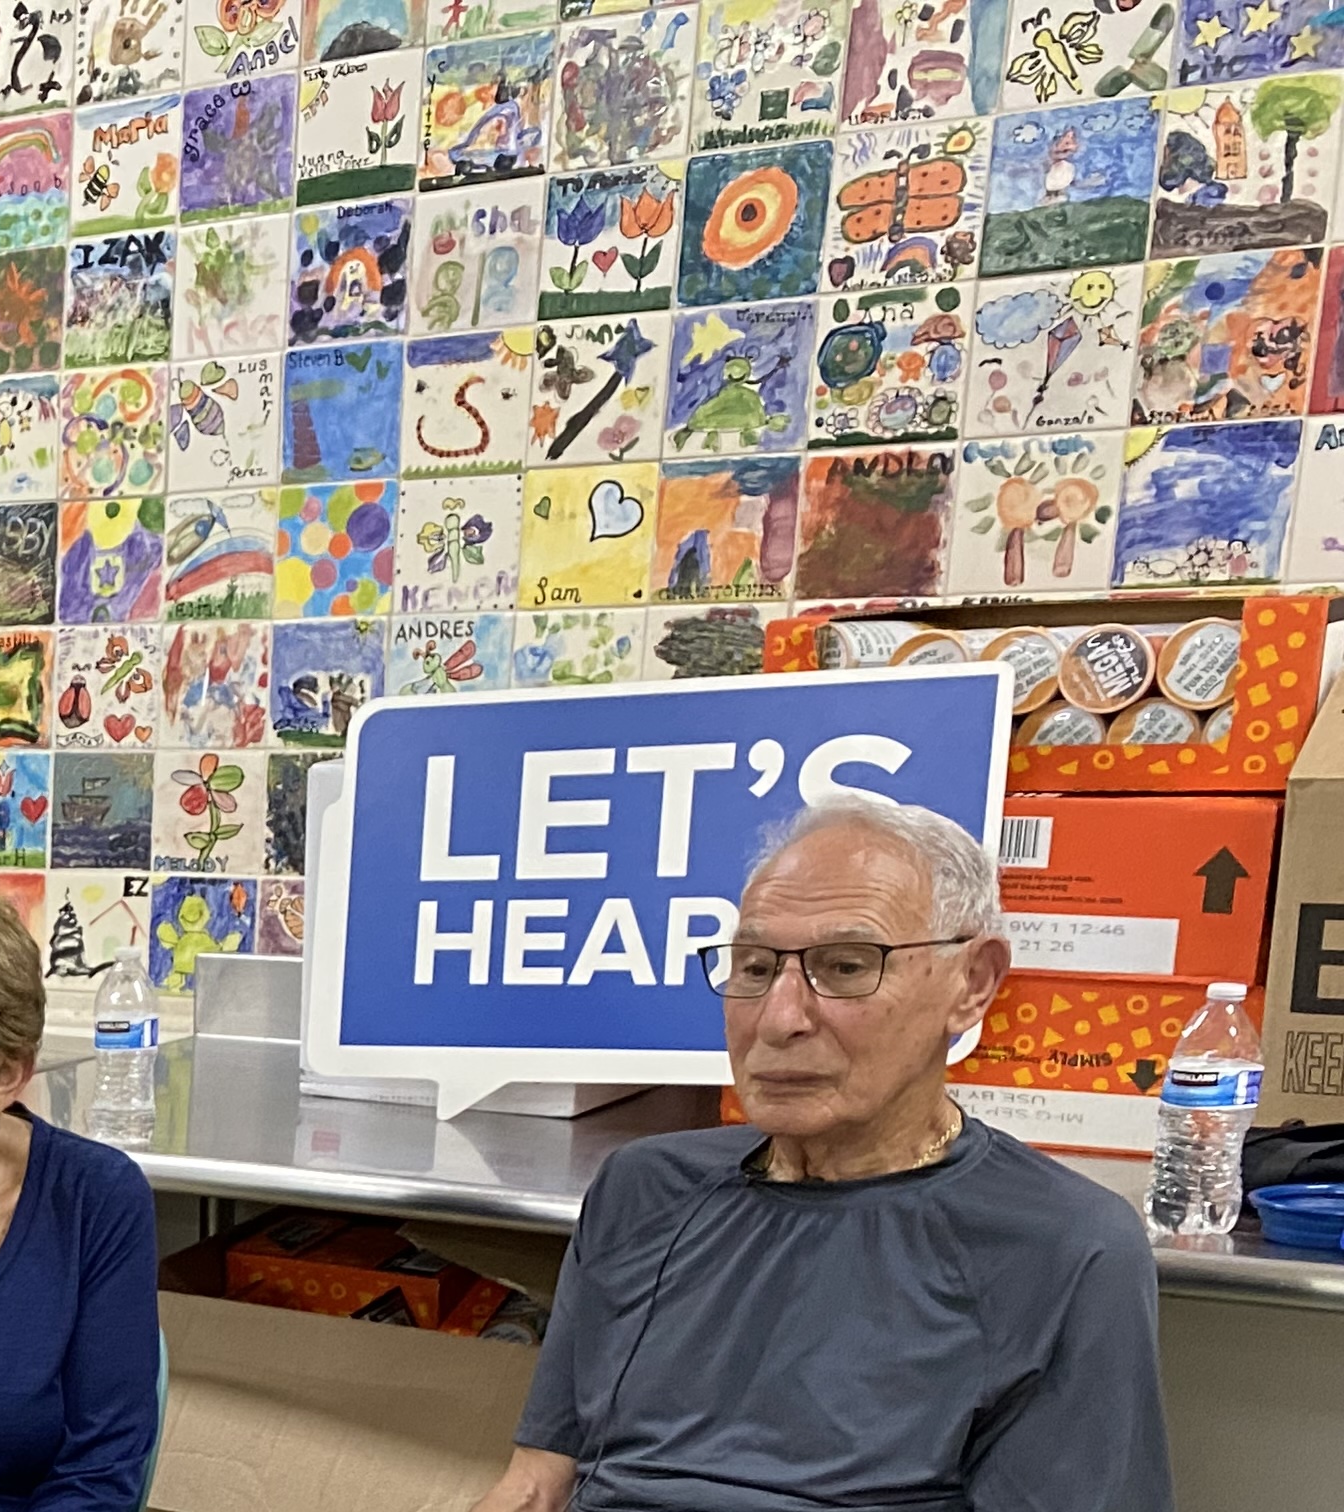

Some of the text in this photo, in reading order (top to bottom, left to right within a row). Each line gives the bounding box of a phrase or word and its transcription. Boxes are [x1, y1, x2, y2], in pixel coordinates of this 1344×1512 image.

[227, 16, 299, 78] Angel
[337, 202, 393, 220] Deborah
[1035, 409, 1095, 428] Gonzalo
[534, 576, 582, 605] Sam
[395, 619, 475, 644] ANDRES
[154, 855, 229, 873] MELODY
[123, 875, 149, 898] EZ
[414, 896, 740, 988] HEAR
